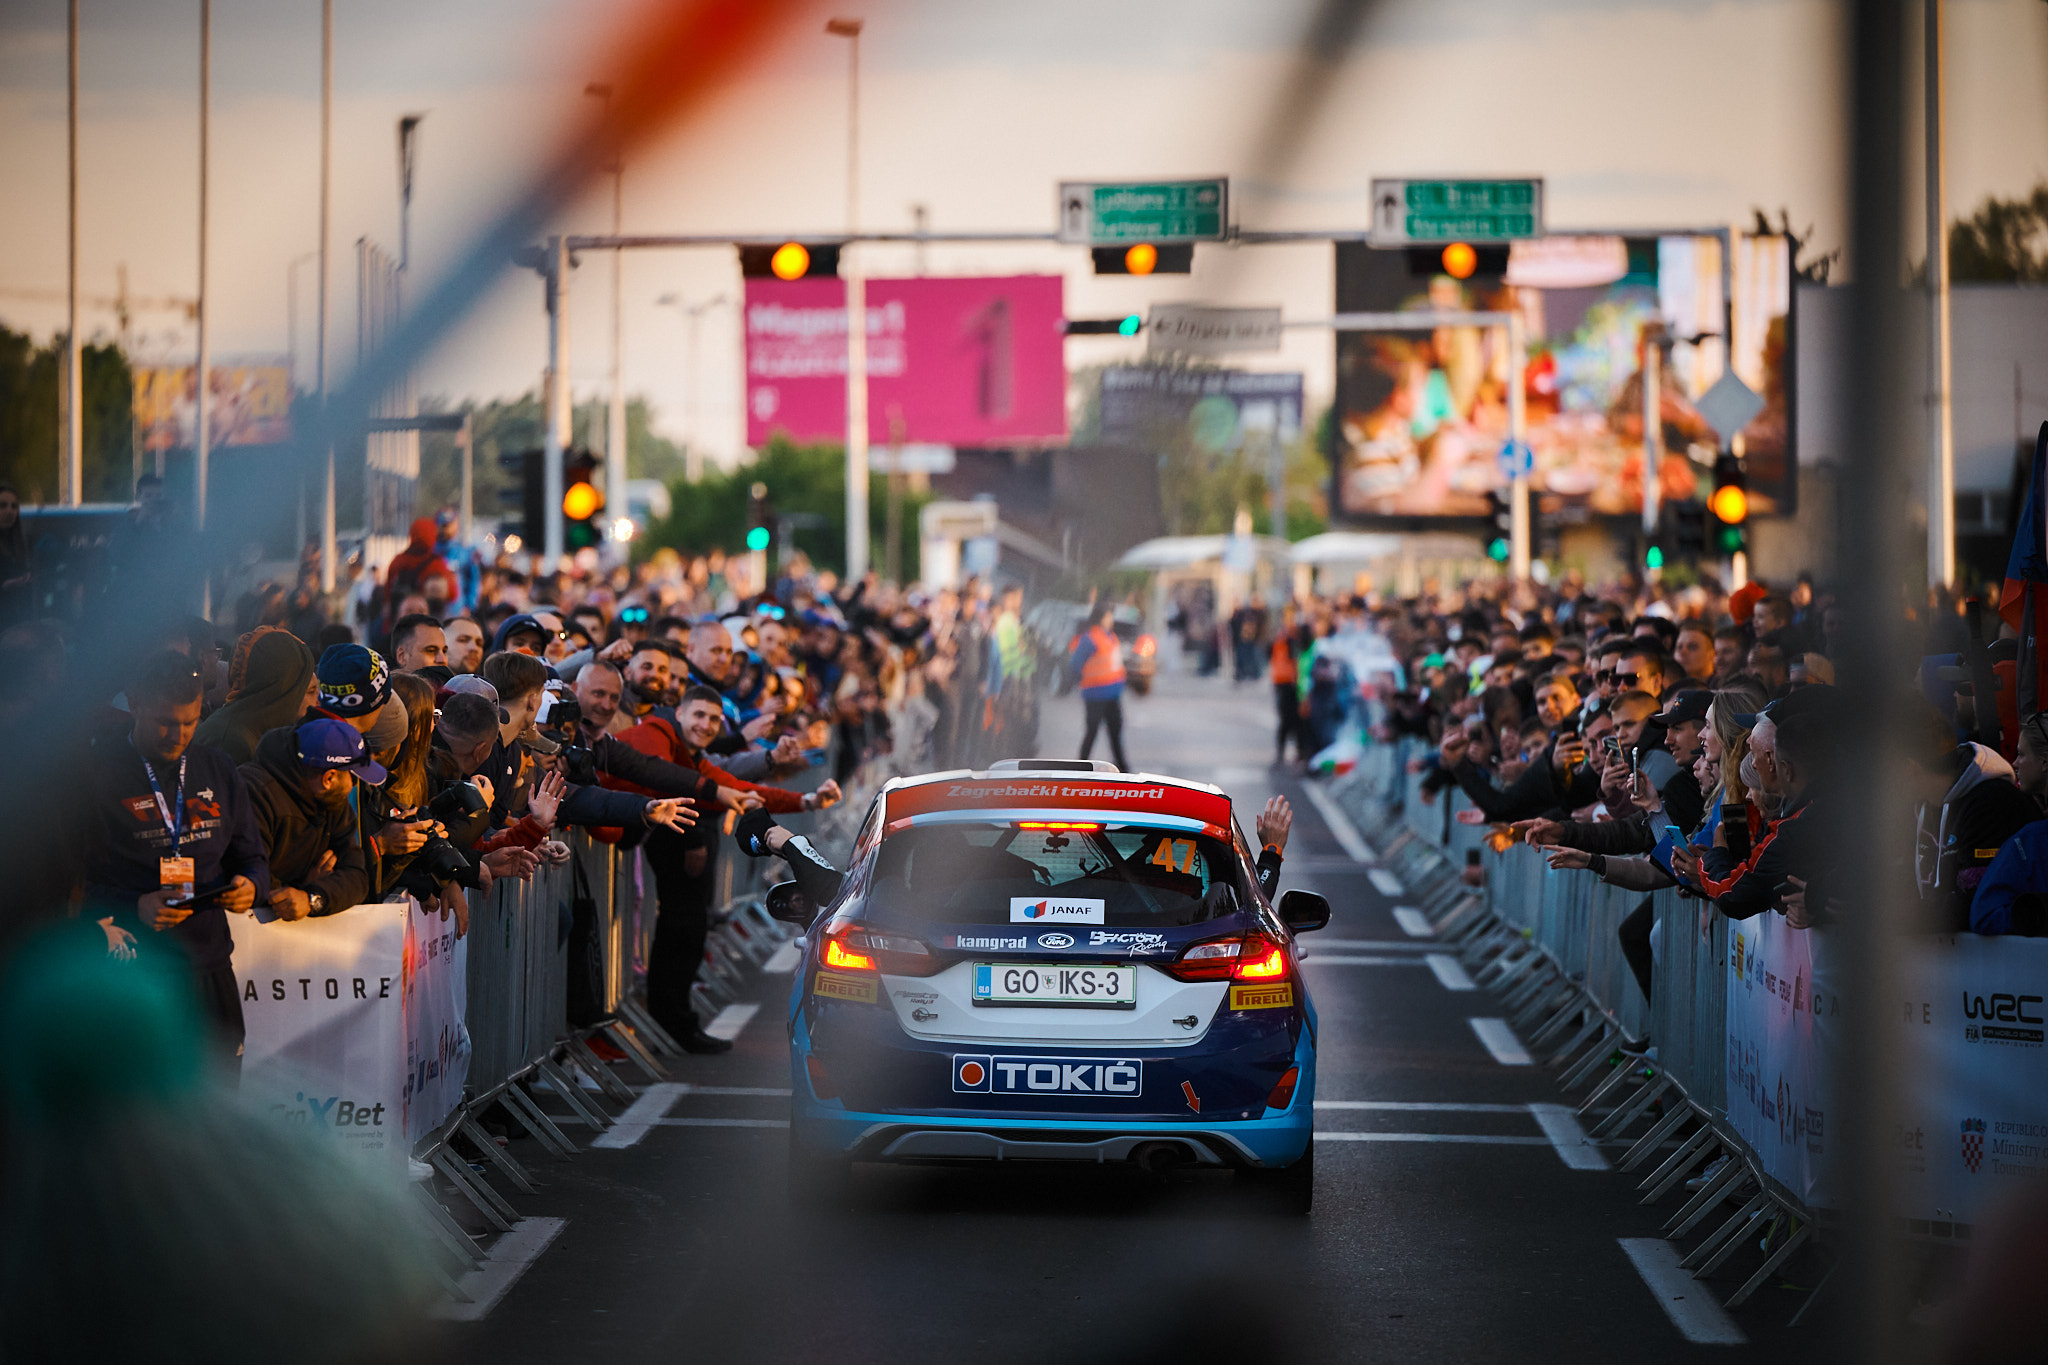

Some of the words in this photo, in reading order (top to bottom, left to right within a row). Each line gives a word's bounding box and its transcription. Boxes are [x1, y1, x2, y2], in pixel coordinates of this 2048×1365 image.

[947, 785, 1056, 798] Zagrebački
[1062, 787, 1164, 800] transporti
[1152, 837, 1198, 874] 47
[1051, 906, 1092, 916] JANAF
[957, 935, 1027, 950] kamgrad
[1046, 936, 1066, 946] Ford
[1126, 940, 1168, 957] Racing
[244, 978, 391, 1001] ASTORE
[817, 976, 871, 999] PIRELLI
[978, 985, 990, 994] SLO
[1004, 969, 1039, 994] GO
[1059, 970, 1119, 995] IKS-3
[1236, 987, 1289, 1006] PIRELLI
[1963, 991, 2044, 1024] WRC
[996, 1060, 1137, 1092] TOKIĆ
[1994, 1121, 2040, 1137] REPUBLIC
[1992, 1138, 2040, 1162] Ministry
